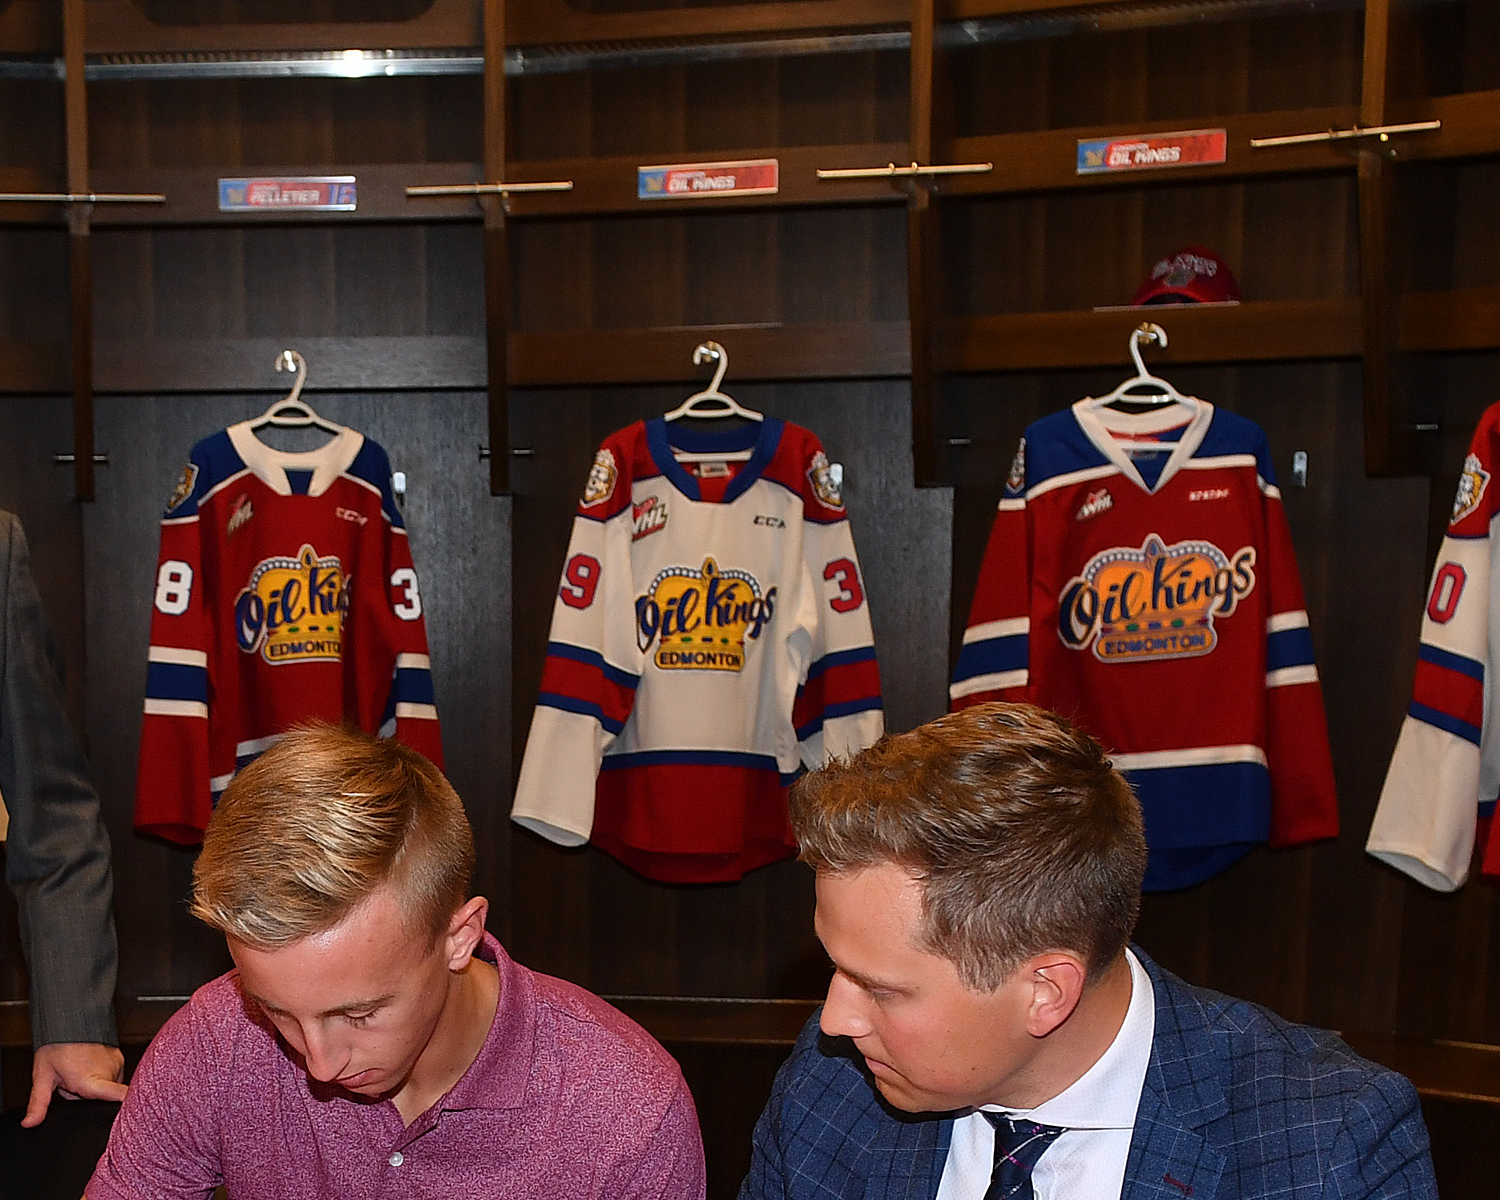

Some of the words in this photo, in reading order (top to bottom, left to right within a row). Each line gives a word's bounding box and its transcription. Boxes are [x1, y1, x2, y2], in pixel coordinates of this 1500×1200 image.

[692, 176, 736, 191] KINGS
[1134, 147, 1181, 164] KINGS
[155, 560, 193, 616] 8
[390, 568, 422, 621] 3
[559, 553, 601, 611] 9
[823, 557, 865, 613] 3
[1058, 570, 1147, 644] Oil
[1151, 552, 1252, 614] Kings
[235, 577, 305, 652] Oil
[634, 588, 701, 654] Oil
[704, 576, 778, 640] Kings
[659, 652, 742, 667] EDMONTON
[1104, 634, 1206, 654] EDMONTON
